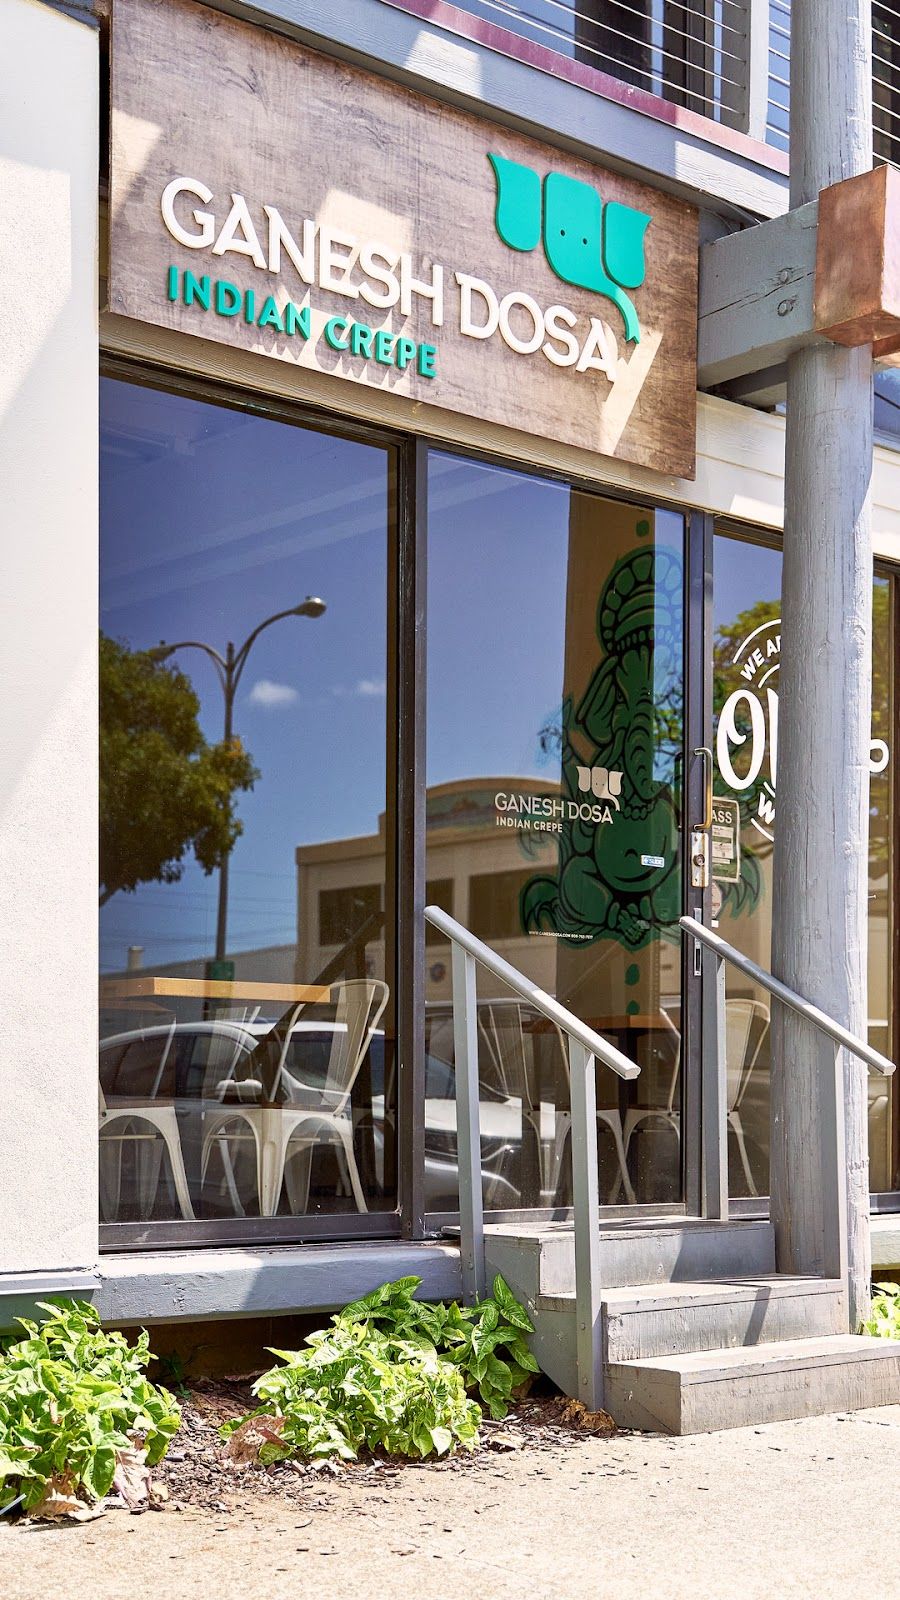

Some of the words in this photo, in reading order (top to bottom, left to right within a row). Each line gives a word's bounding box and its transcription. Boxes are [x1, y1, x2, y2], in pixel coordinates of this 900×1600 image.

[161, 177, 444, 327] GANESH
[454, 271, 617, 383] DOSA
[168, 265, 311, 341] INDIAN
[324, 314, 438, 378] CREPE
[740, 647, 765, 681] WE
[494, 792, 565, 819] GANESH
[567, 801, 614, 825] DOSA
[496, 816, 531, 830] INDIAN
[533, 820, 563, 833] CREPE
[712, 809, 733, 824] ASS
